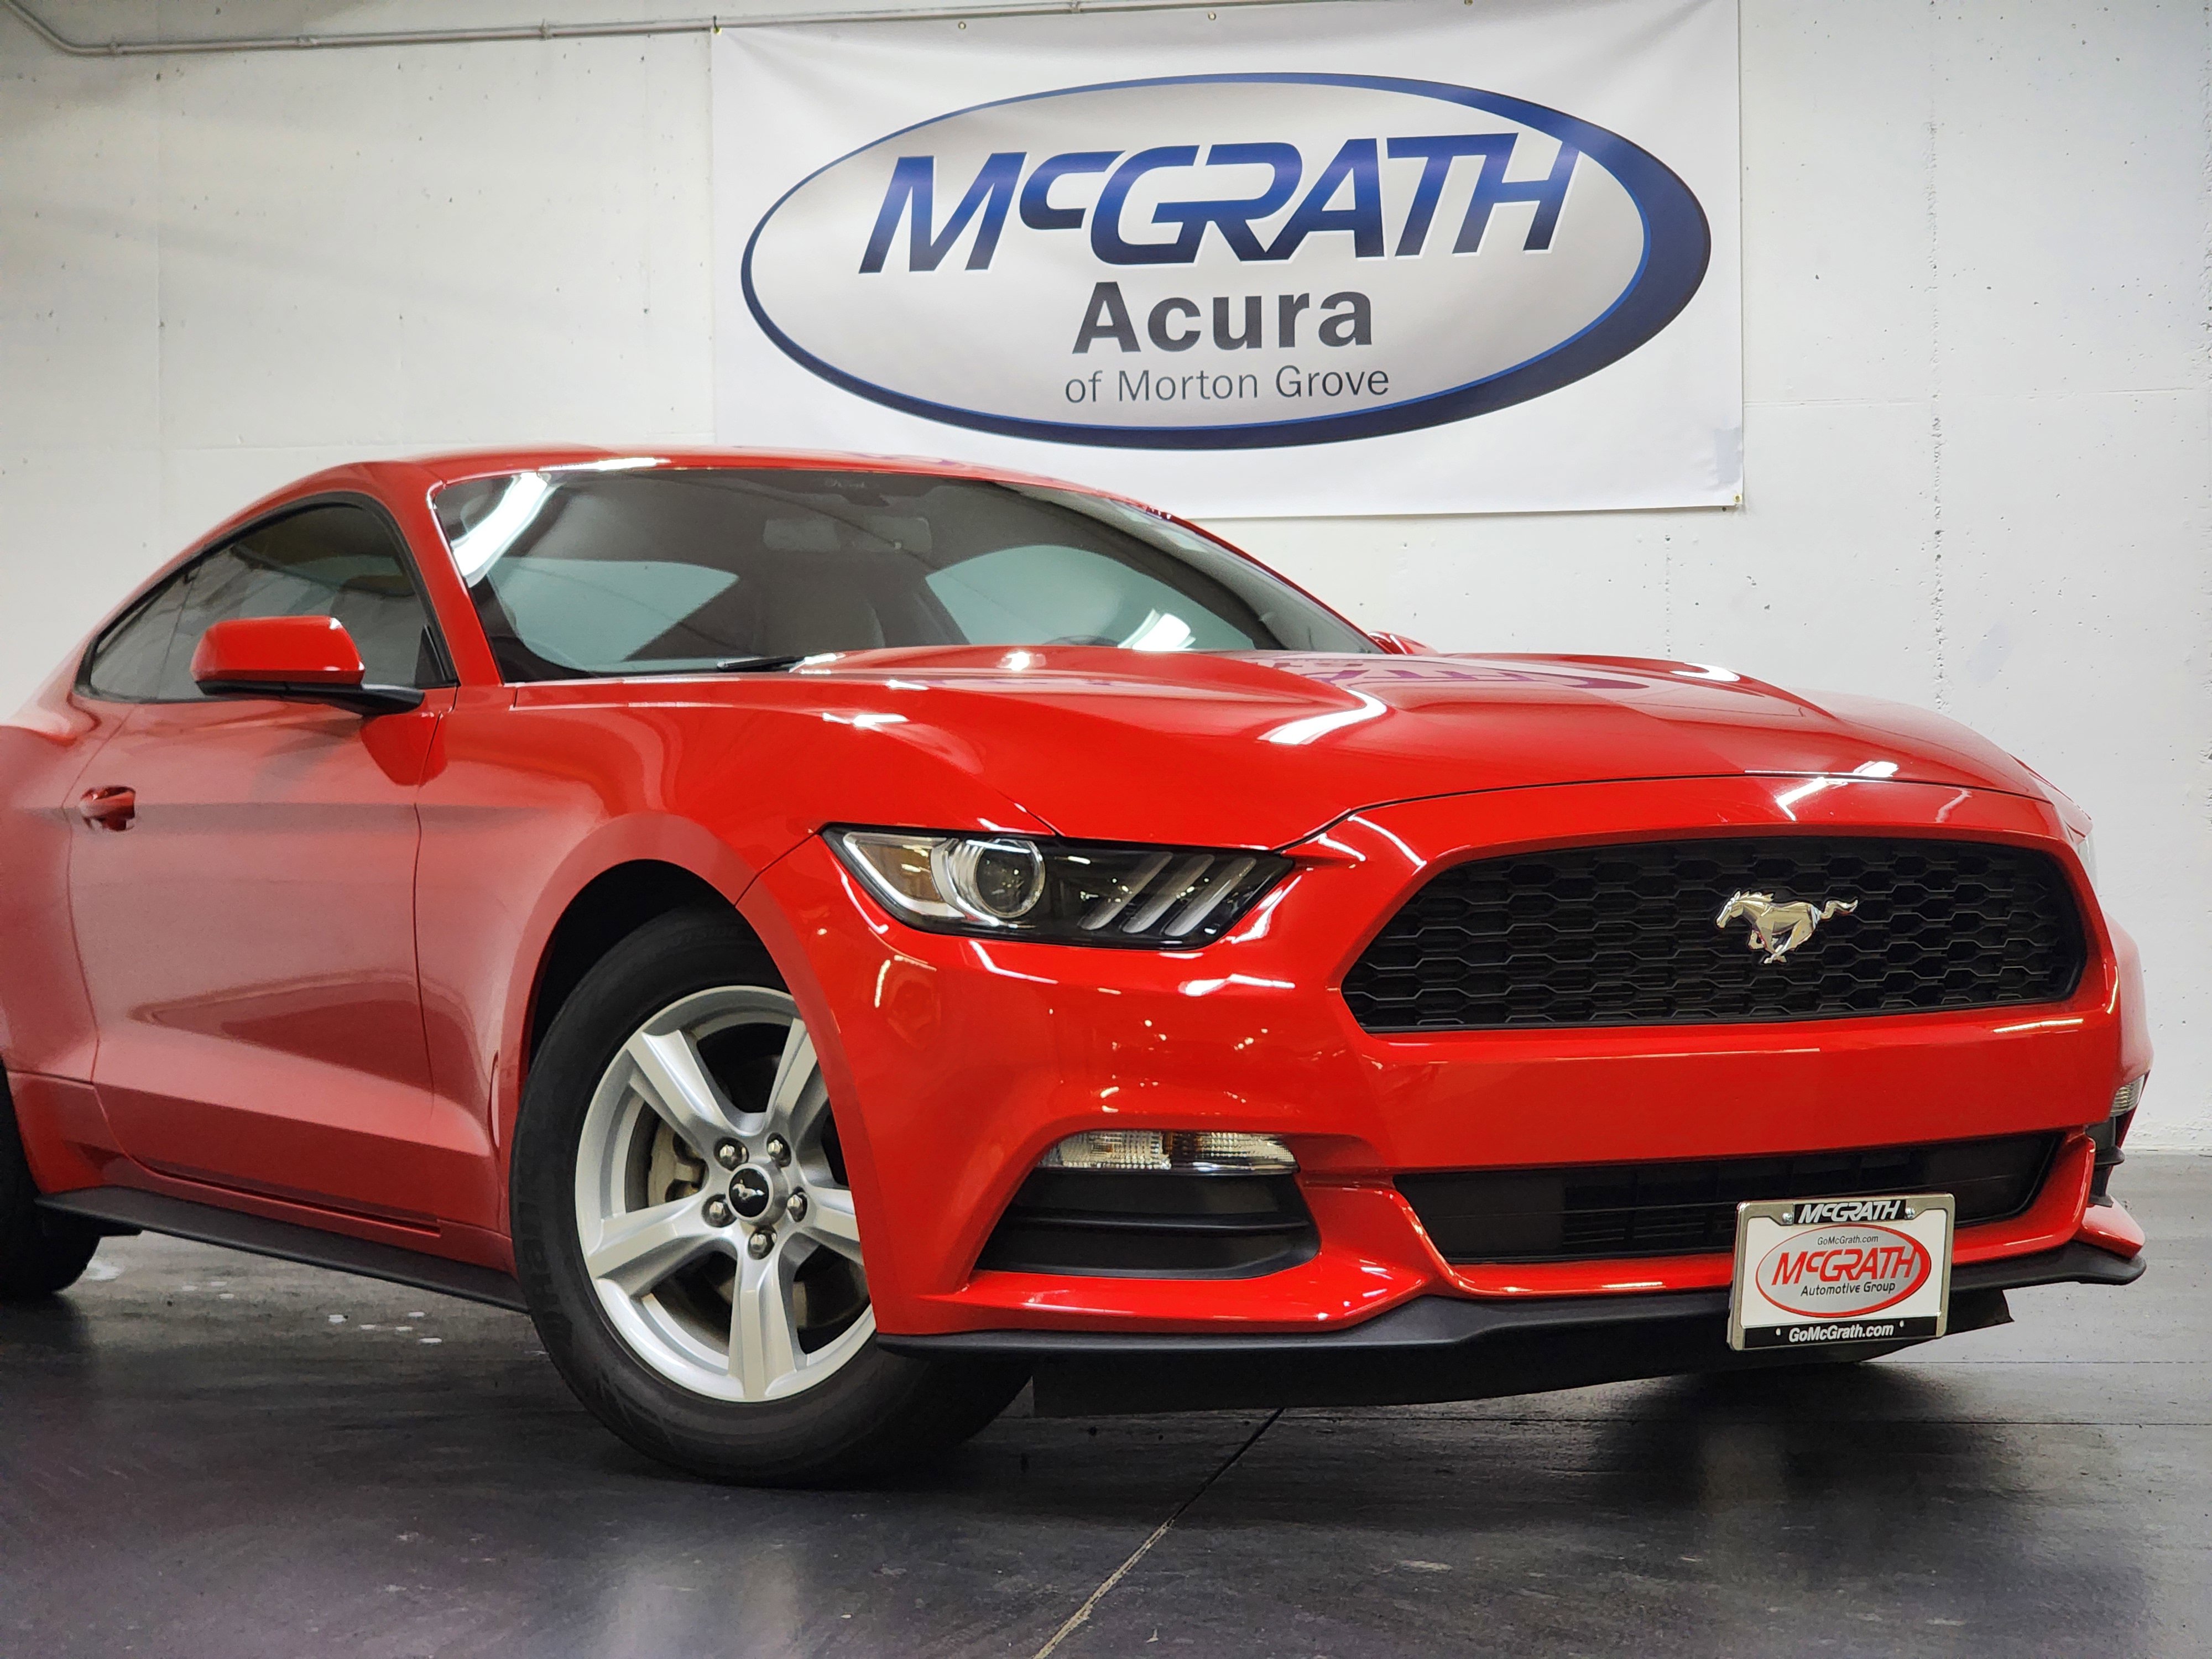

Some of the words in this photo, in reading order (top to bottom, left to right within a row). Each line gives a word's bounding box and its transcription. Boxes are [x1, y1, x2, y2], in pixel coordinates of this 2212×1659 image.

[858, 132, 1580, 274] McGRATH
[1072, 281, 1372, 354] Acura
[1065, 370, 1103, 403] of
[1118, 370, 1259, 402] Morton
[1276, 364, 1390, 398] Grove
[1798, 1200, 1901, 1224] McGRATH
[1817, 1234, 1879, 1245] GoMcGrath.com
[1771, 1246, 1916, 1286] McGRATH
[1800, 1283, 1860, 1297] Automotive
[1863, 1281, 1896, 1295] Group
[1788, 1322, 1894, 1343] GoMcGrath.com
